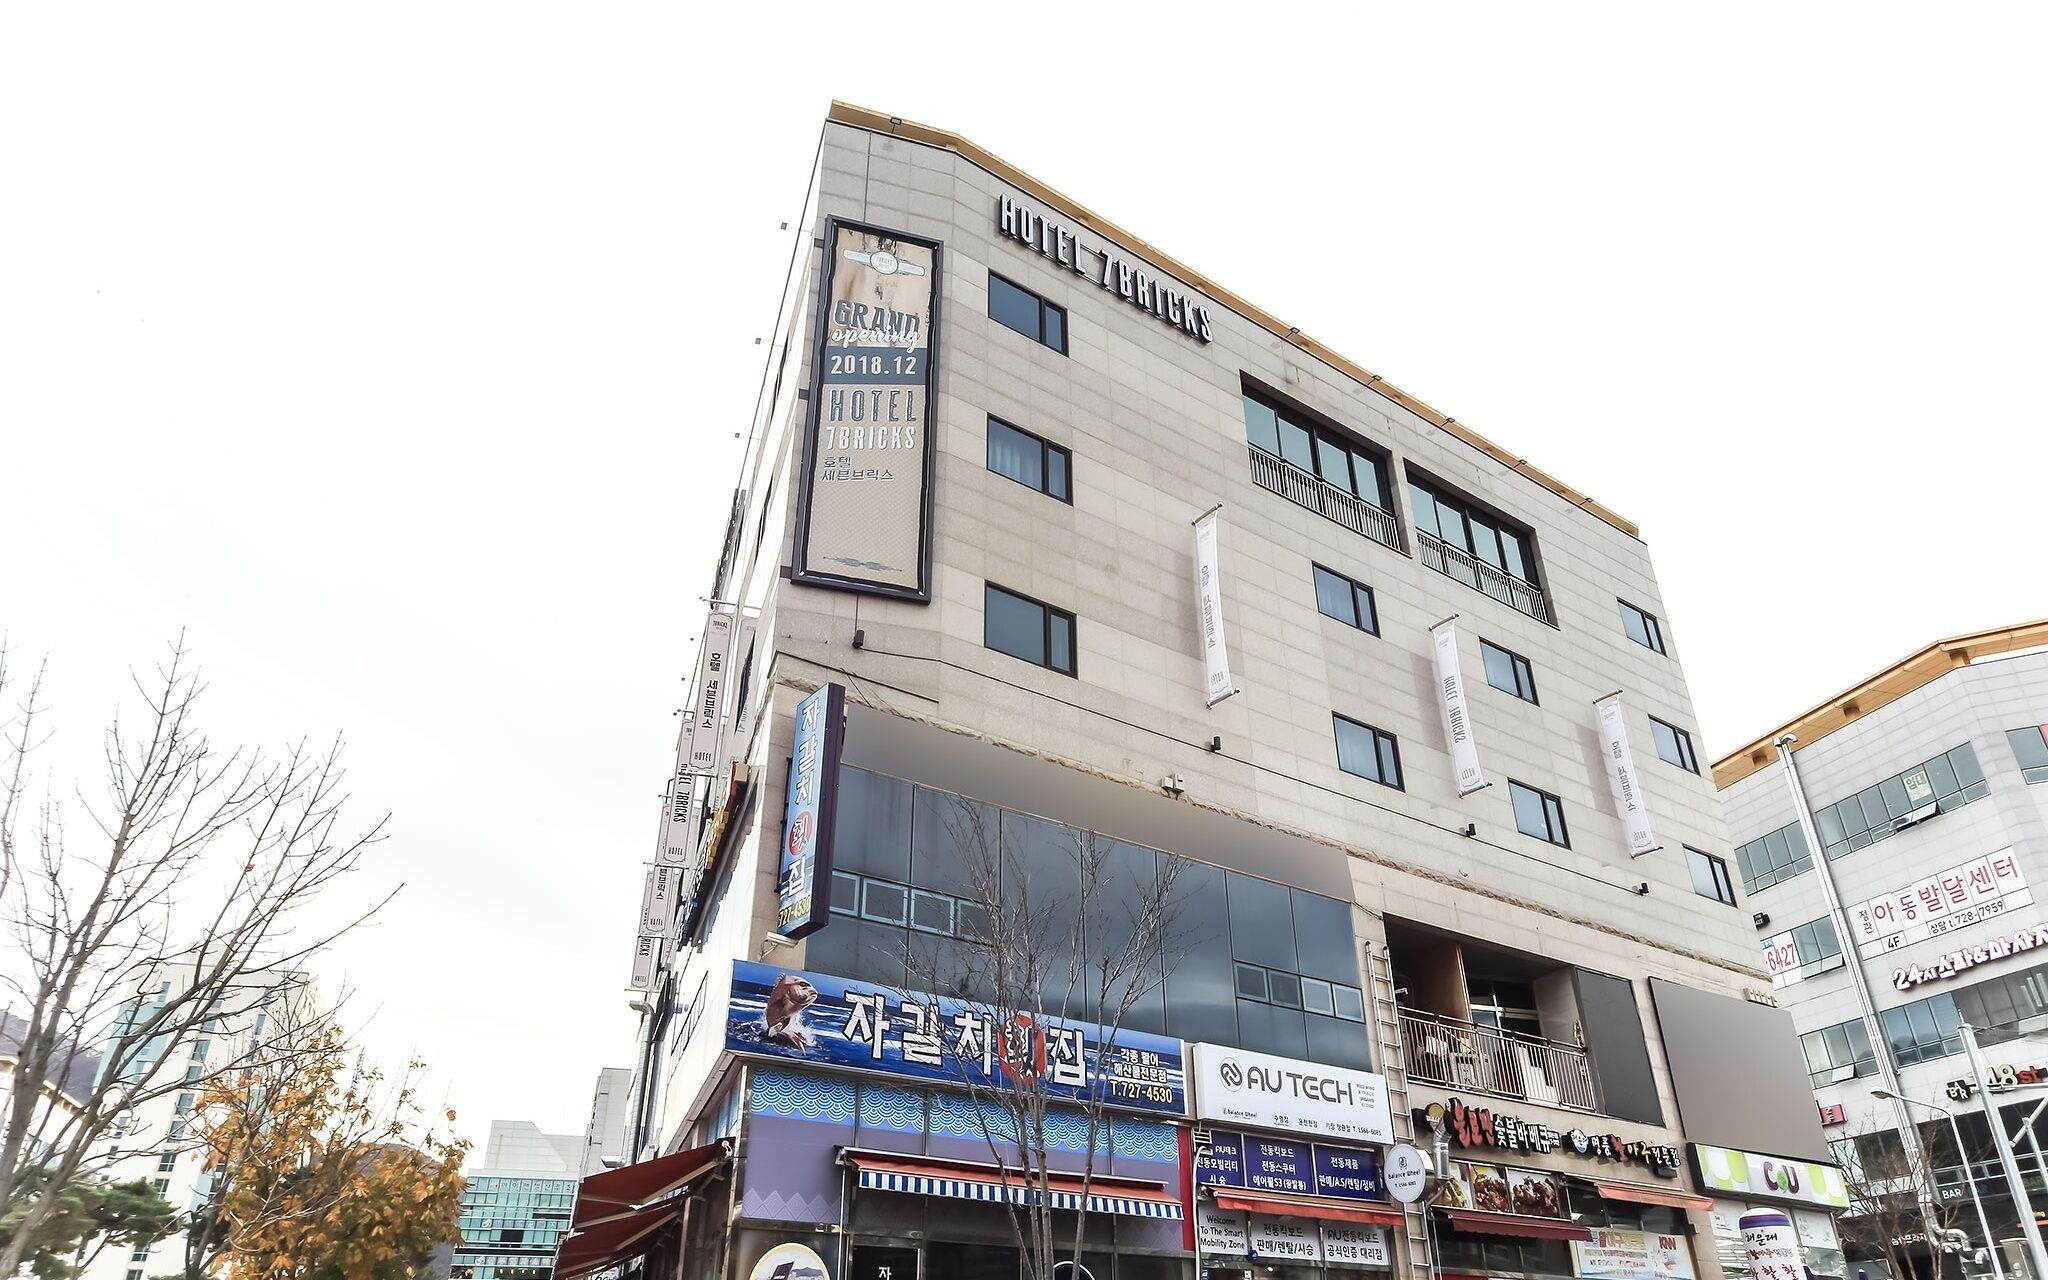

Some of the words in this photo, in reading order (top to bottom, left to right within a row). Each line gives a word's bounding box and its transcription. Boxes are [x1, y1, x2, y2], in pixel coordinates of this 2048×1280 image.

[1000, 193, 1086, 274] HOTEL
[1100, 250, 1213, 343] 7BRICKS
[833, 299, 921, 338] GRAND
[832, 326, 922, 353] opening
[831, 355, 917, 375] 2018.12
[829, 389, 917, 422] HOTEL
[826, 426, 916, 450] 7BRICKS
[824, 456, 851, 469] 호텔
[822, 469, 894, 481] 세븐브릭스
[709, 652, 722, 672] 호텔
[701, 679, 718, 729] 세븐브릭스
[694, 751, 712, 762] HOTEL
[1906, 772, 1927, 790] 임대
[673, 791, 690, 823] 7BRICKS
[668, 846, 683, 856] HOTEL
[1874, 856, 2019, 923] 아동발달센터
[1858, 909, 1874, 935] 정관
[1930, 919, 1947, 934] 상담
[1887, 935, 1901, 949] 4F
[1120, 1048, 1139, 1064] 각종
[1113, 1063, 1167, 1083] 해산물전문점
[1110, 1080, 1173, 1104] T.727-4530
[1227, 1108, 1244, 1117] Balance
[1260, 1144, 1295, 1158] 전동킥보드
[1261, 1160, 1296, 1175] 전동스쿠터
[1330, 1157, 1359, 1170] 전동제품
[1388, 1171, 1405, 1180] Balance
[1942, 1188, 1962, 1199] BAR
[1206, 1215, 1236, 1226] Welcome
[1201, 1226, 1210, 1237] To
[1211, 1227, 1223, 1237] The
[1224, 1228, 1243, 1238] Smart
[1263, 1223, 1304, 1238] 전동킥보드
[1745, 1229, 1778, 1246] 해운대
[1200, 1238, 1227, 1250] Mobility
[1228, 1240, 1245, 1250] Zone
[1327, 1245, 1358, 1259] 공식인증
[1360, 1247, 1383, 1261] 대리점
